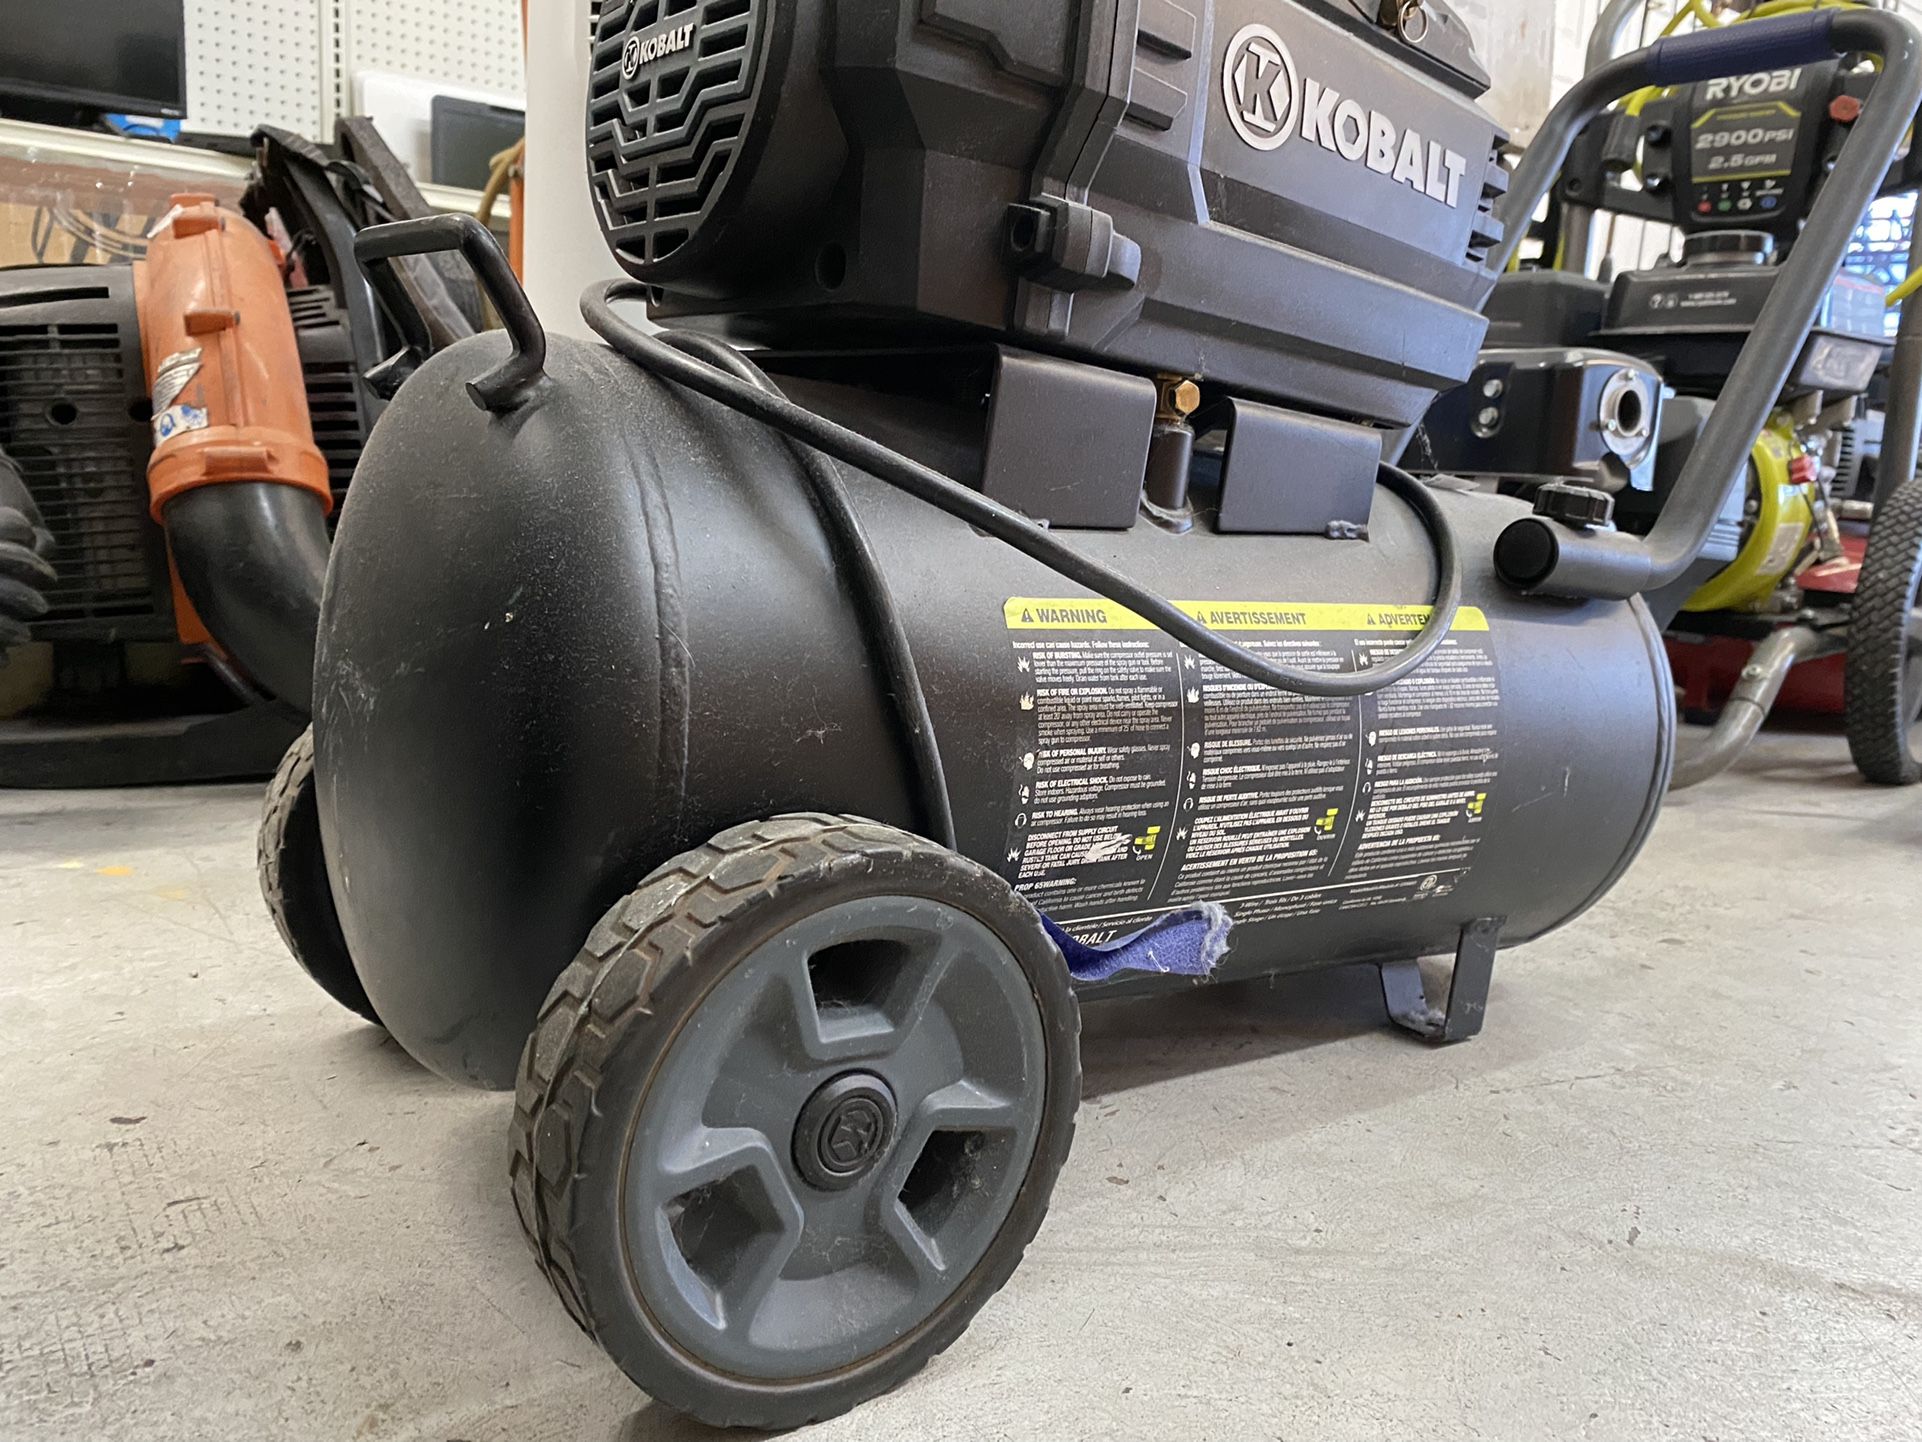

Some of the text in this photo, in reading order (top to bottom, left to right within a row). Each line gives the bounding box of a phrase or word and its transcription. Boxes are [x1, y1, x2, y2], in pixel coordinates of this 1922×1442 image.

[639, 22, 695, 65] KOBALT
[1706, 71, 1802, 100] RYOBI
[1300, 77, 1467, 208] KOBALT
[1695, 127, 1794, 149] 2900 PSI
[1709, 153, 1744, 169] 2.5
[1036, 609, 1107, 623] WARNING
[1211, 612, 1307, 624] AVERTISSEMENT
[1052, 749, 1059, 757] OF
[1058, 778, 1088, 786] ELECTRICAL
[1028, 831, 1062, 841] DISCONNECT
[1078, 828, 1097, 836] SUPPLY
[1098, 826, 1118, 834] CIRCUIT
[1073, 929, 1117, 946] BALT
